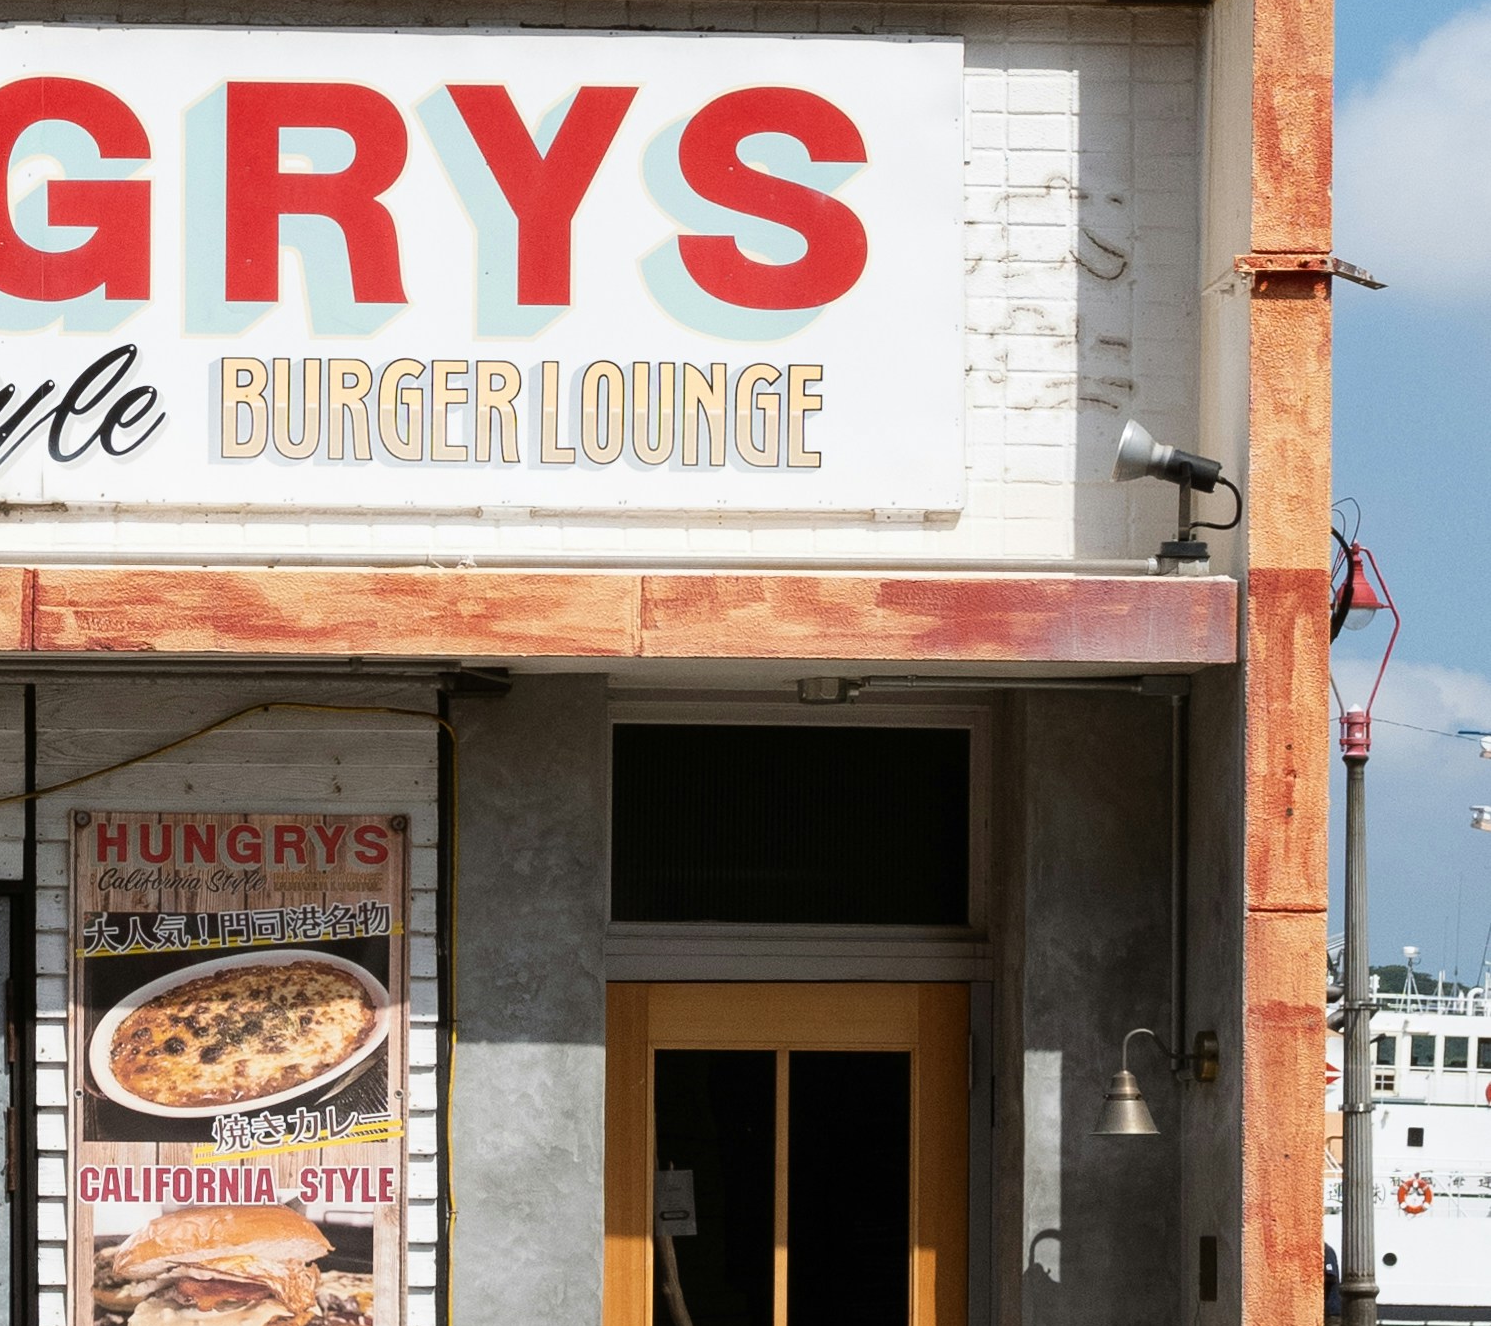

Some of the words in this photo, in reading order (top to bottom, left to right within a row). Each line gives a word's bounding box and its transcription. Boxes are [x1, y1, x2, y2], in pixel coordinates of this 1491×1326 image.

[220, 356, 522, 464] BURGER
[539, 360, 824, 469] LOUNGE
[95, 822, 390, 866] HUNGRYS
[97, 867, 202, 893] California
[205, 868, 268, 894] Style
[211, 1106, 393, 1153] 焼きカレー
[79, 1166, 276, 1204] CALIFORNIA
[300, 1166, 396, 1204] STYLE
